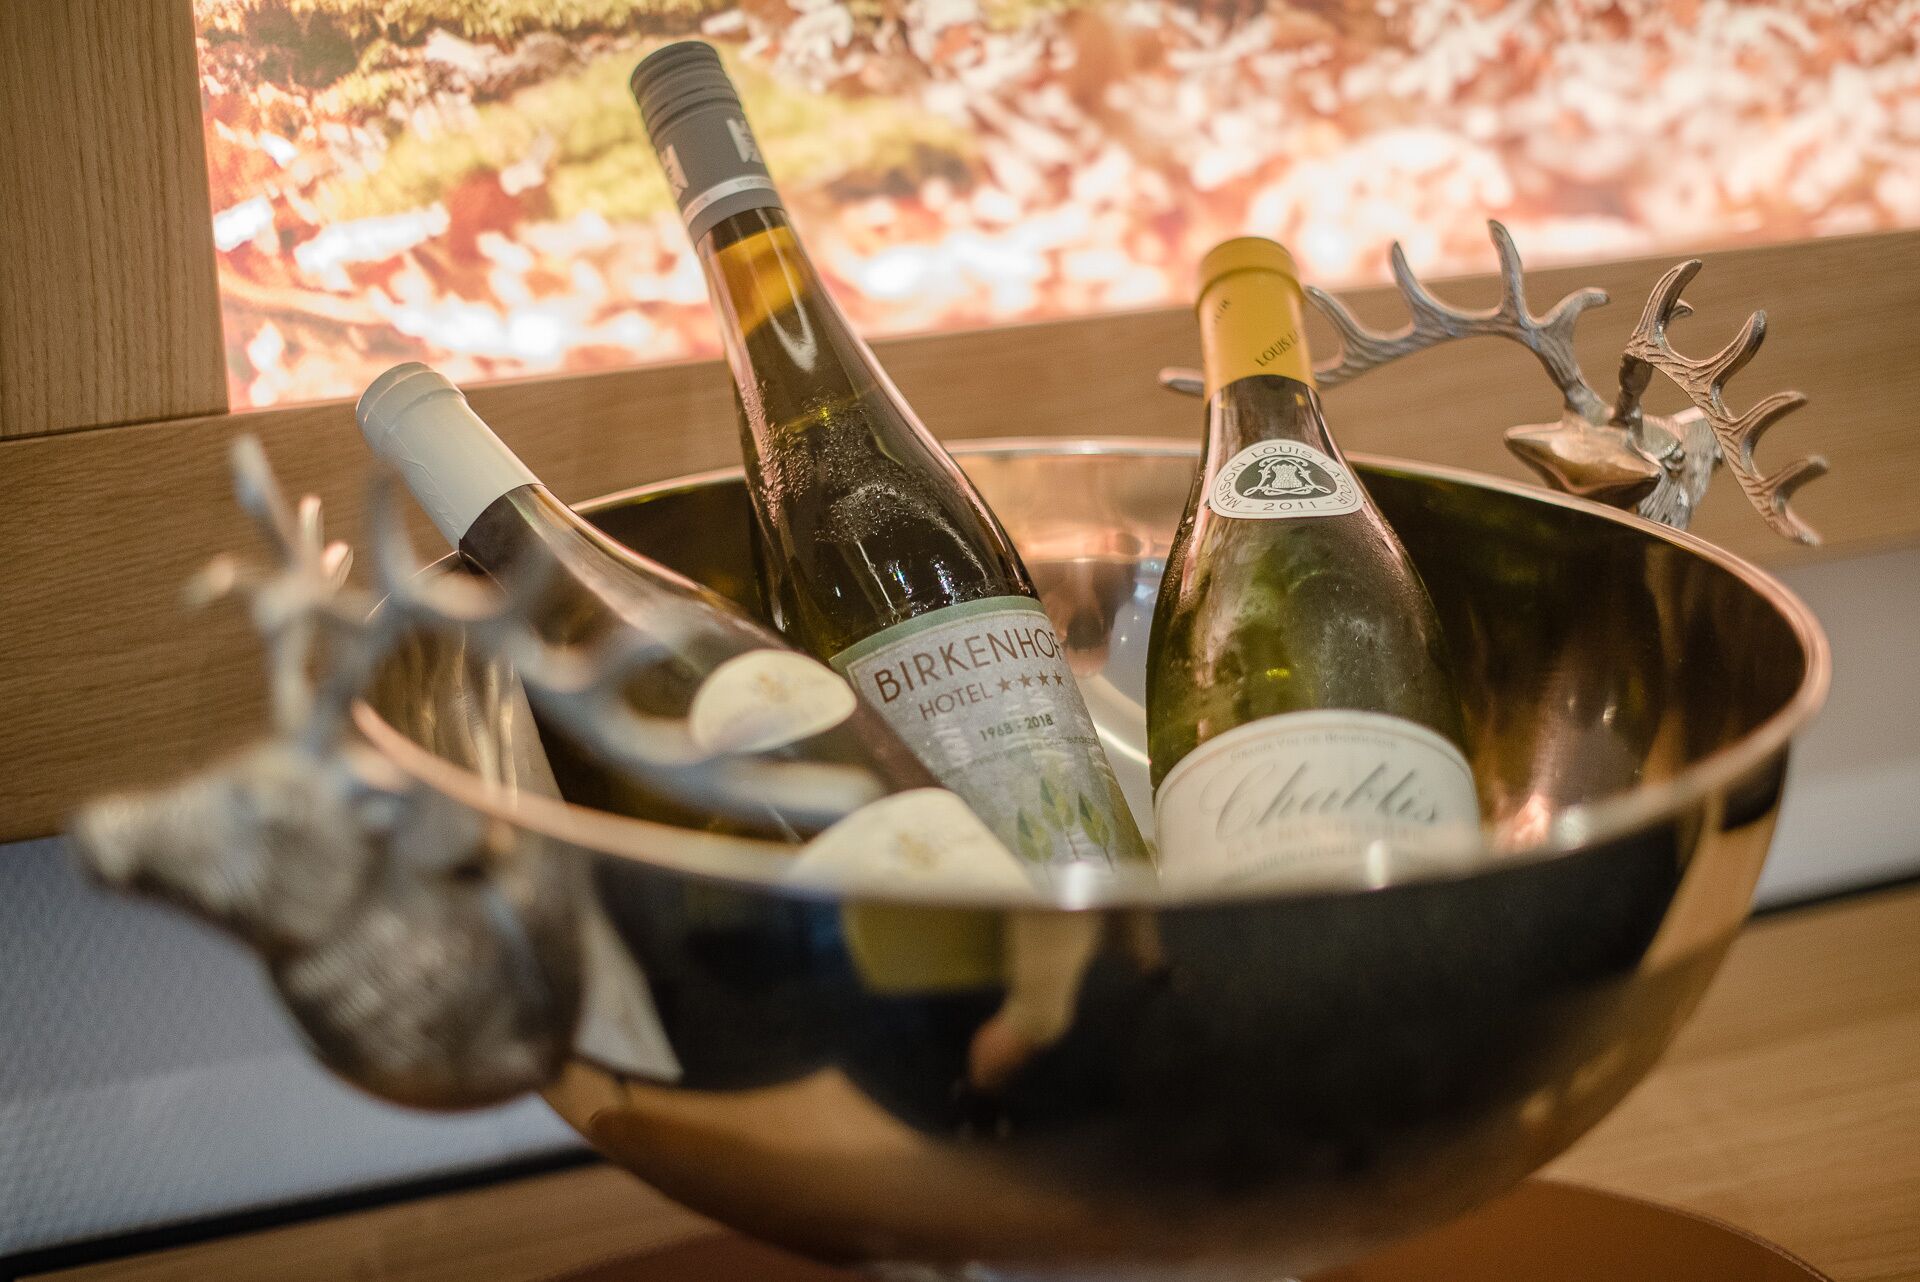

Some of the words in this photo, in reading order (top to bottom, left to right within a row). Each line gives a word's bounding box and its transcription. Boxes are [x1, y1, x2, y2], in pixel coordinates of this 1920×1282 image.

[1255, 336, 1290, 367] LOUIS
[1219, 462, 1246, 509] MAISON
[1251, 445, 1313, 459] LOUIS
[1319, 461, 1353, 505] LATOUR
[1263, 501, 1317, 511] 2011
[918, 682, 993, 721] HOTEL
[979, 722, 1013, 741] 1968
[1024, 714, 1054, 730] 2018
[1200, 757, 1438, 842] Chablis
